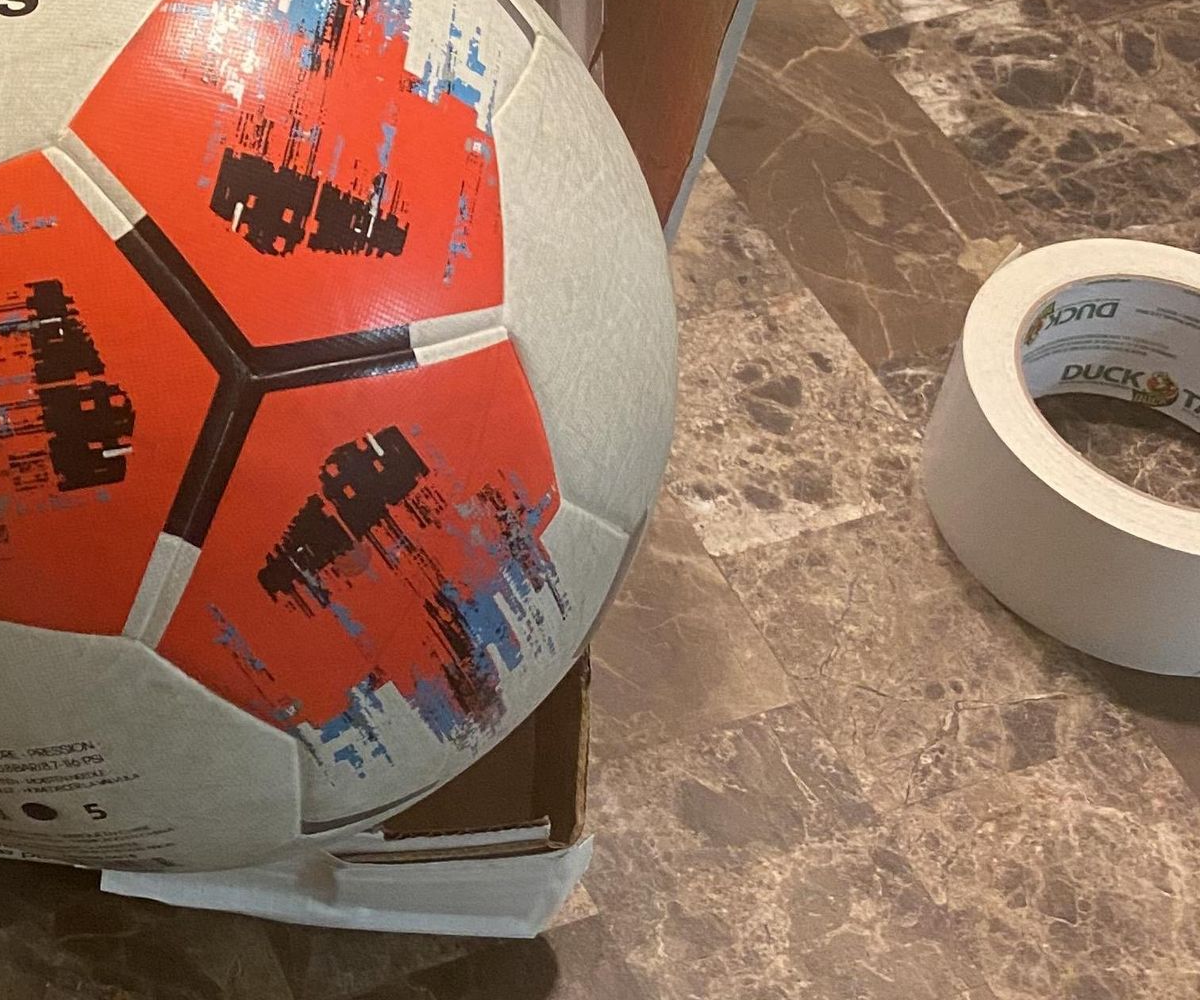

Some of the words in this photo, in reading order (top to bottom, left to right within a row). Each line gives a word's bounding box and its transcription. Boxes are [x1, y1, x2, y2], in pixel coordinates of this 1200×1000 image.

[1045, 301, 1119, 330] DUCK
[1060, 364, 1146, 388] DUCK
[82, 802, 108, 820] 5
